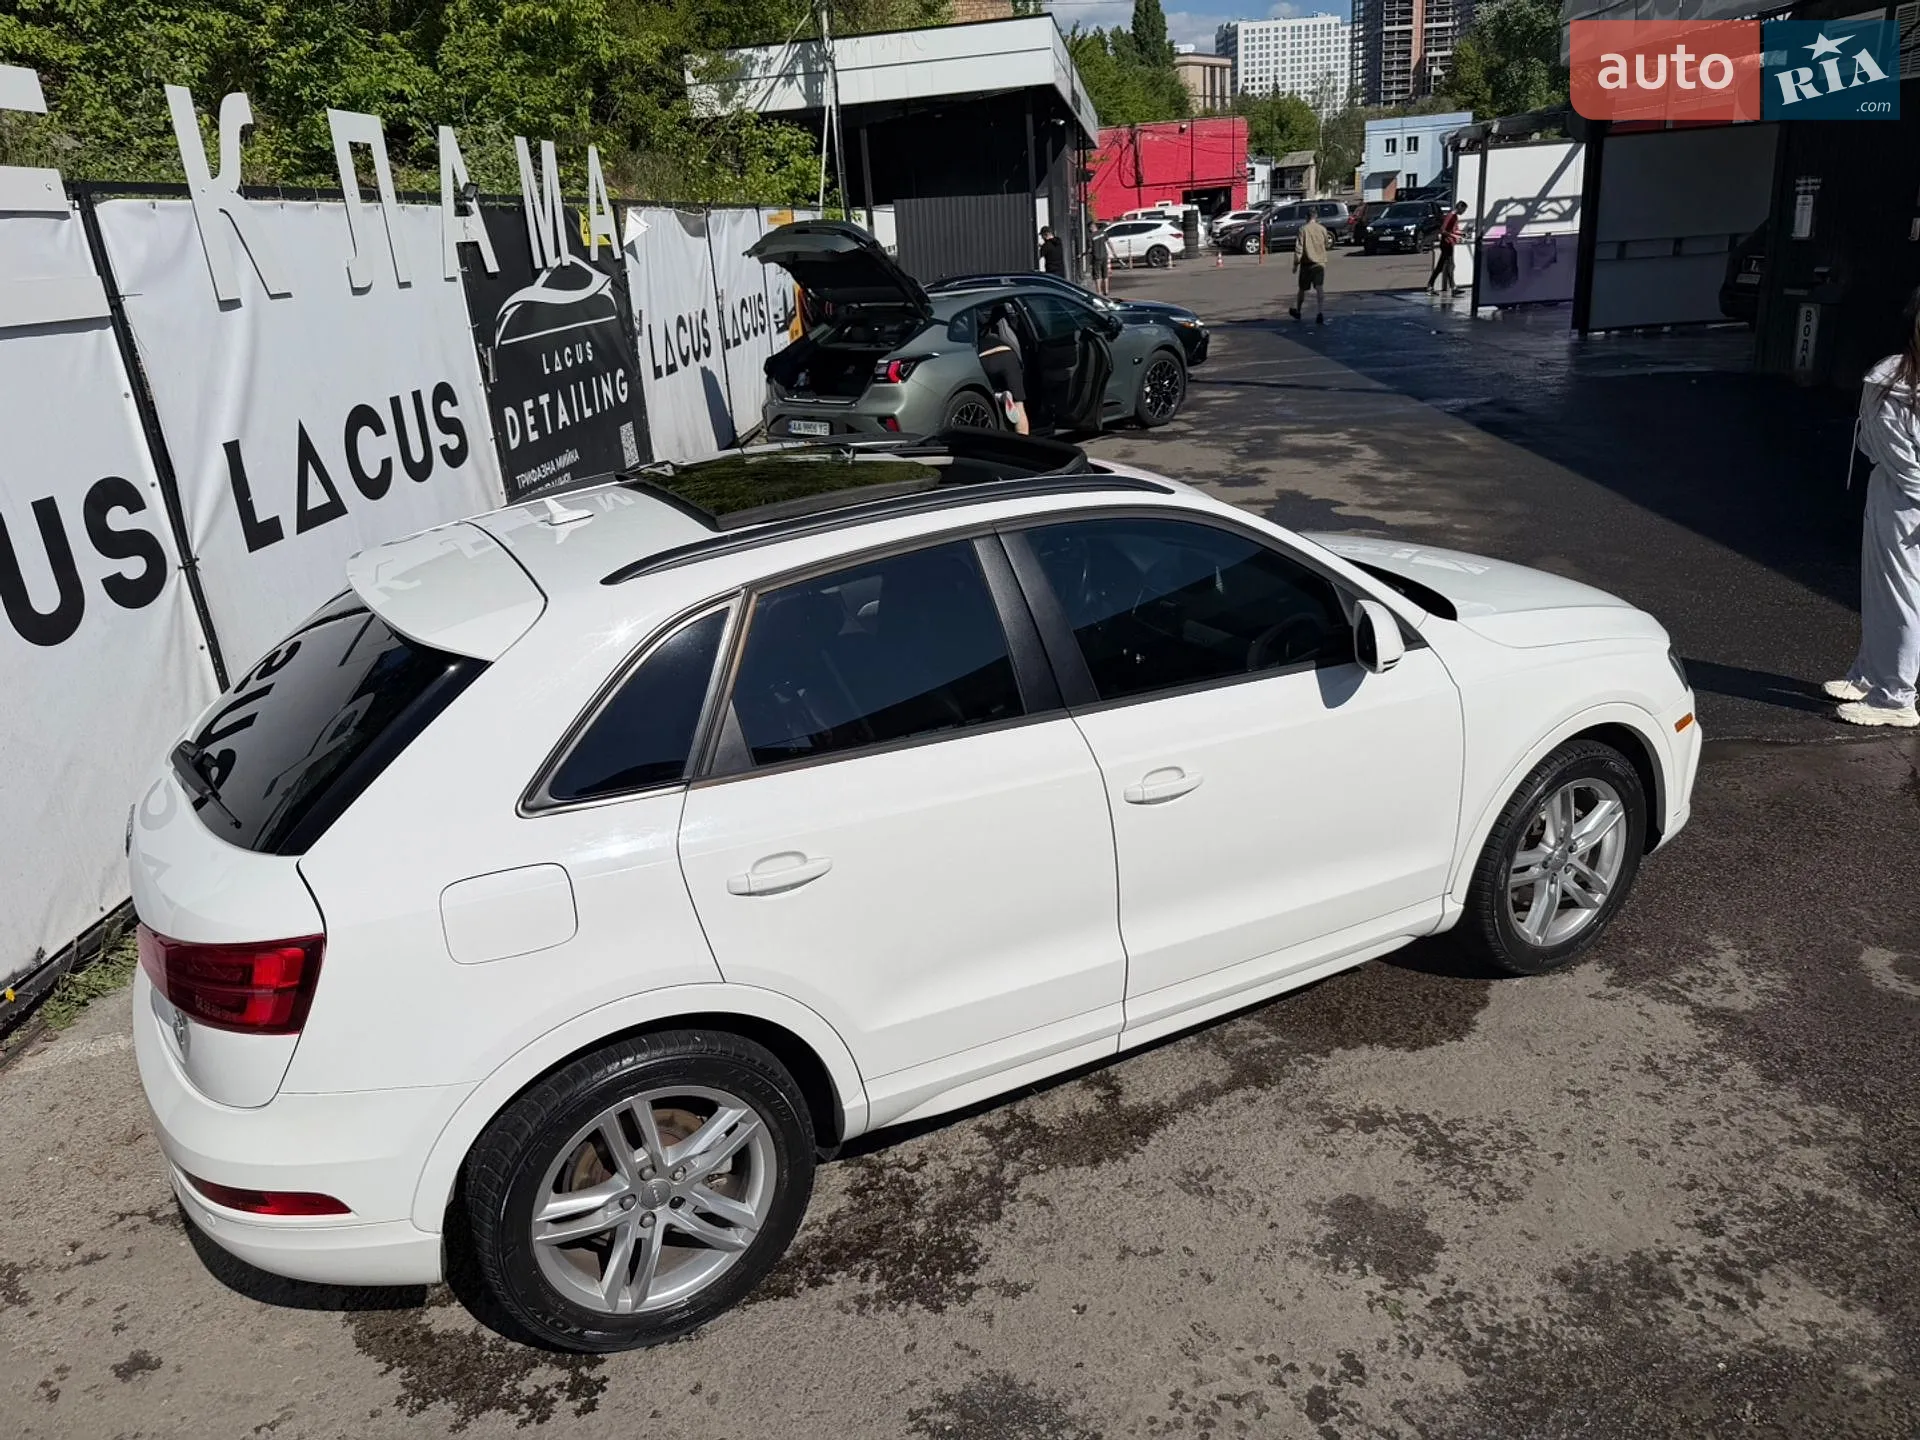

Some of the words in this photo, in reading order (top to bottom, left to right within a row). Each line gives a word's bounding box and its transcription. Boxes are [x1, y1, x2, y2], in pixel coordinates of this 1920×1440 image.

[648, 307, 712, 380] LACUS
[720, 292, 767, 350] LACUS
[1799, 310, 1813, 368] ВОДА
[541, 341, 594, 375] LACUS
[503, 367, 629, 450] DETAILING
[222, 381, 470, 554] LACUS
[515, 460, 557, 489] ТРИФАЗНА
[555, 448, 580, 471] МИЙКА
